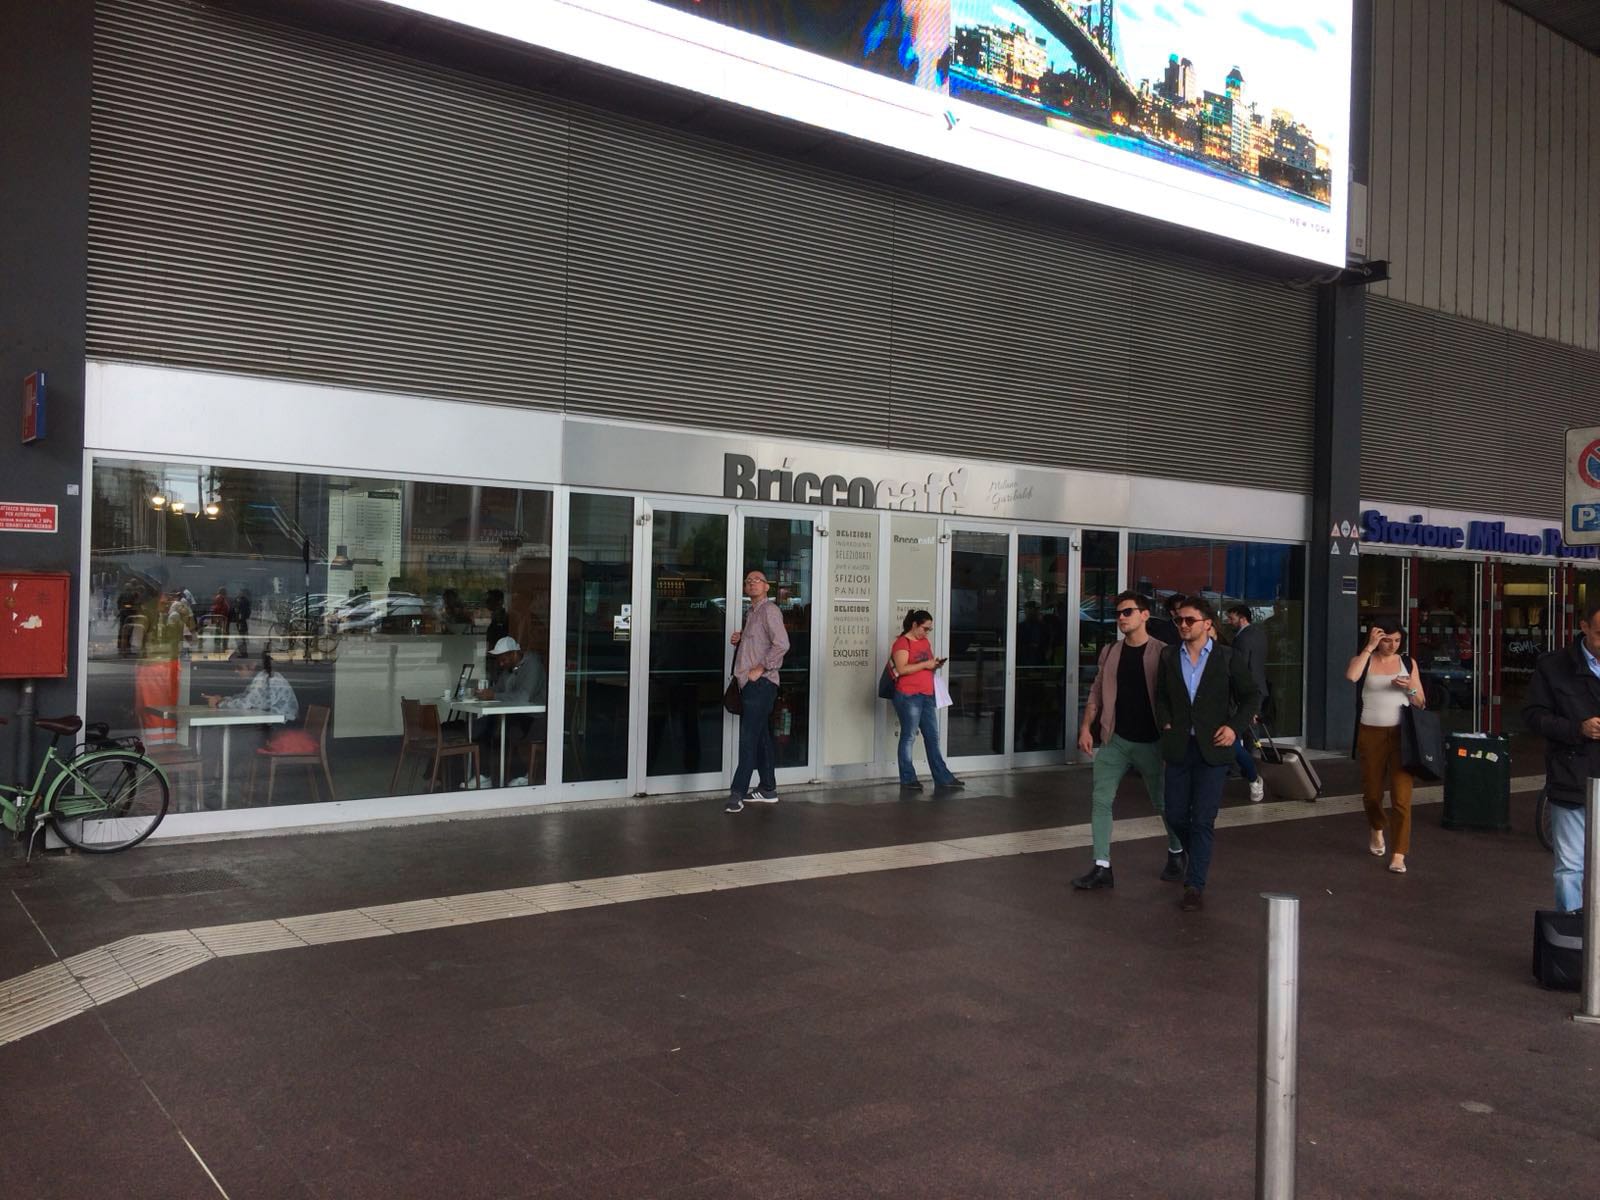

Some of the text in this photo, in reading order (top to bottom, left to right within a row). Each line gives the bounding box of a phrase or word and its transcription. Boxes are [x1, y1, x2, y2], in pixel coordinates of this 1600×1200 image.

[836, 530, 872, 539] DELIZIOSI
[1362, 509, 1464, 549] Stazione
[1465, 520, 1542, 556] Milano
[835, 574, 871, 583] SFIZIOSI
[834, 586, 871, 595] PANINI
[834, 605, 870, 613] DELICIOUS
[833, 624, 870, 634] SELECTED
[833, 649, 869, 658] EXQUISITE
